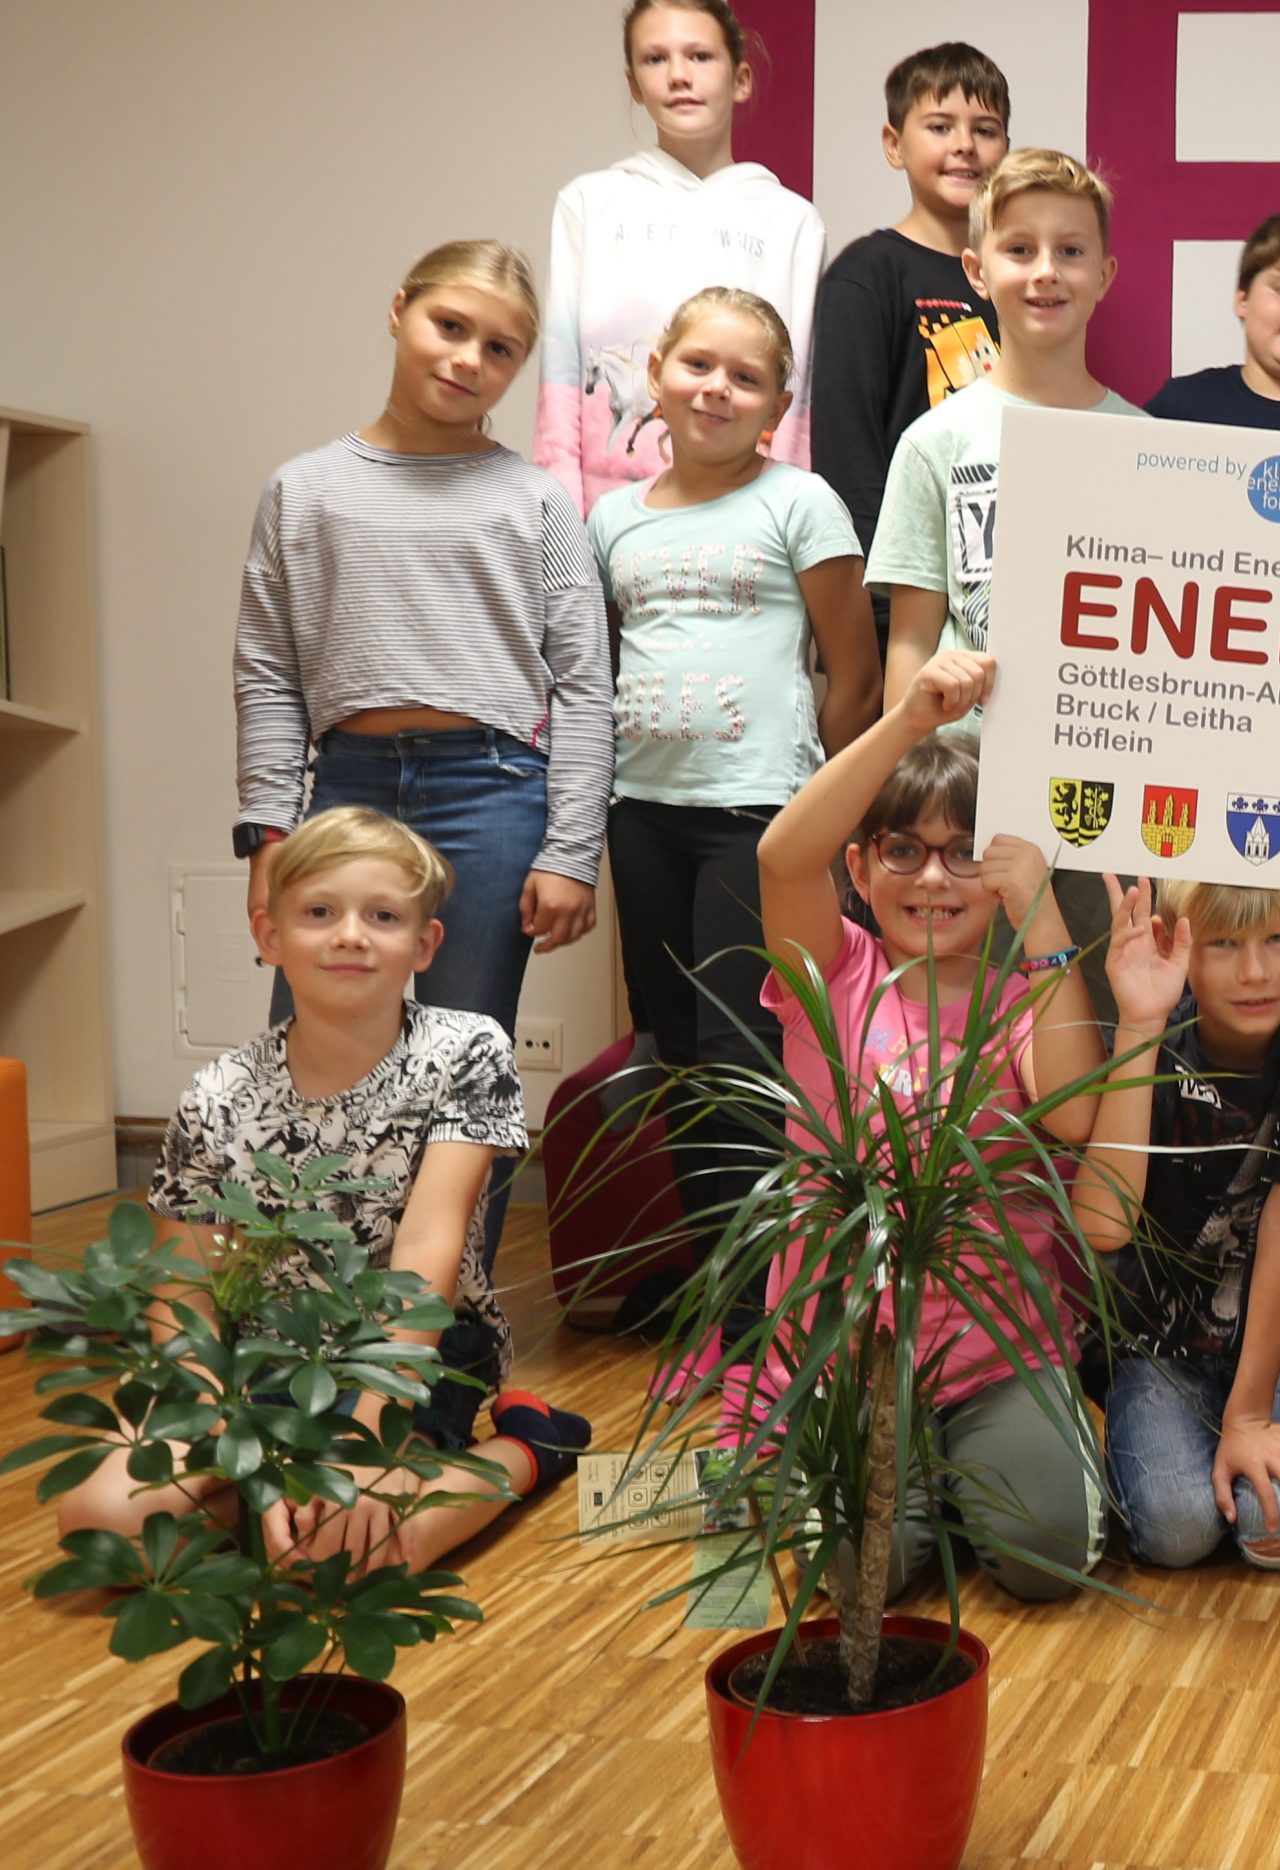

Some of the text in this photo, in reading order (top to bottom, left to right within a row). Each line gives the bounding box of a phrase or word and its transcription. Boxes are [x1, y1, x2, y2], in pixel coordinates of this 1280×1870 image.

[1136, 452, 1247, 481] powered by
[1171, 550, 1224, 573] und
[1055, 693, 1140, 723] Bruck
[1165, 703, 1253, 734] Leitha
[1054, 723, 1153, 754] Höflein
